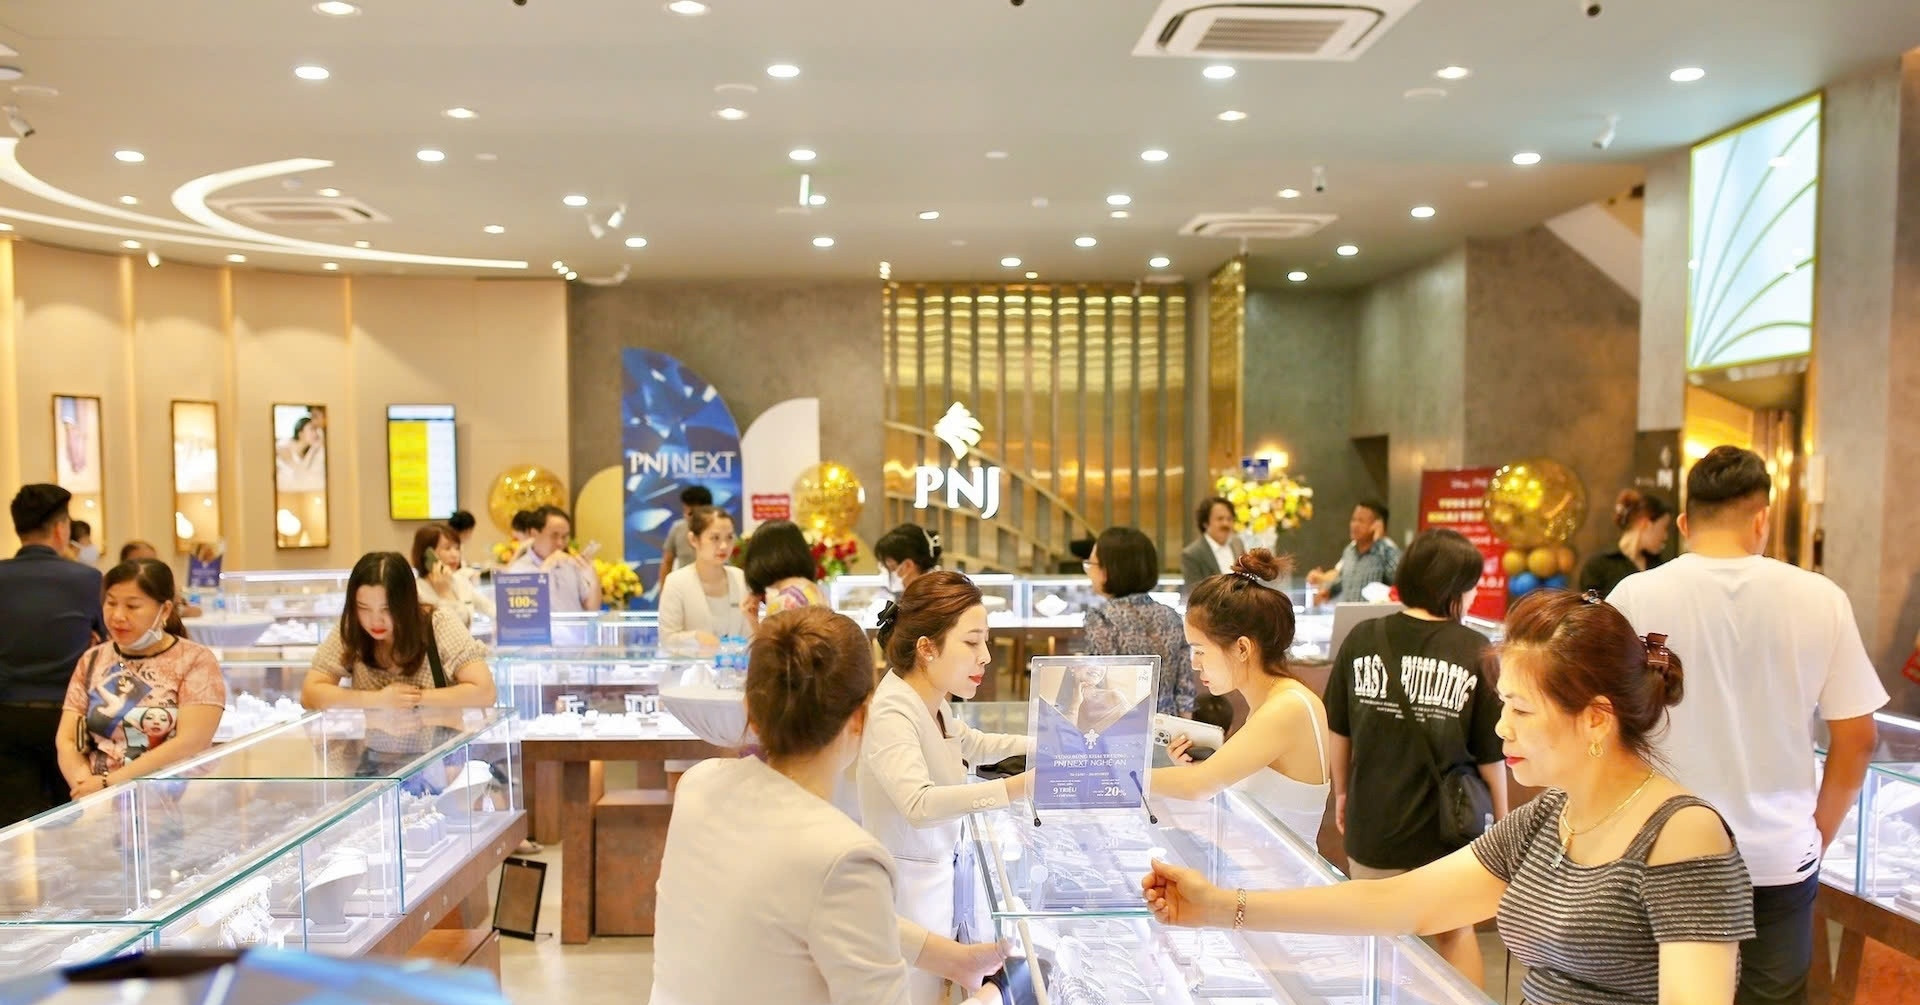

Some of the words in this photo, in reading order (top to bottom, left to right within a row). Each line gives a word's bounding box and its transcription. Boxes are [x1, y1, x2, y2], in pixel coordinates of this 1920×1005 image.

[628, 451, 669, 478] PNJ
[672, 451, 736, 474] NEXT
[913, 466, 1001, 519] PNJ
[1401, 655, 1478, 712] BUILDING
